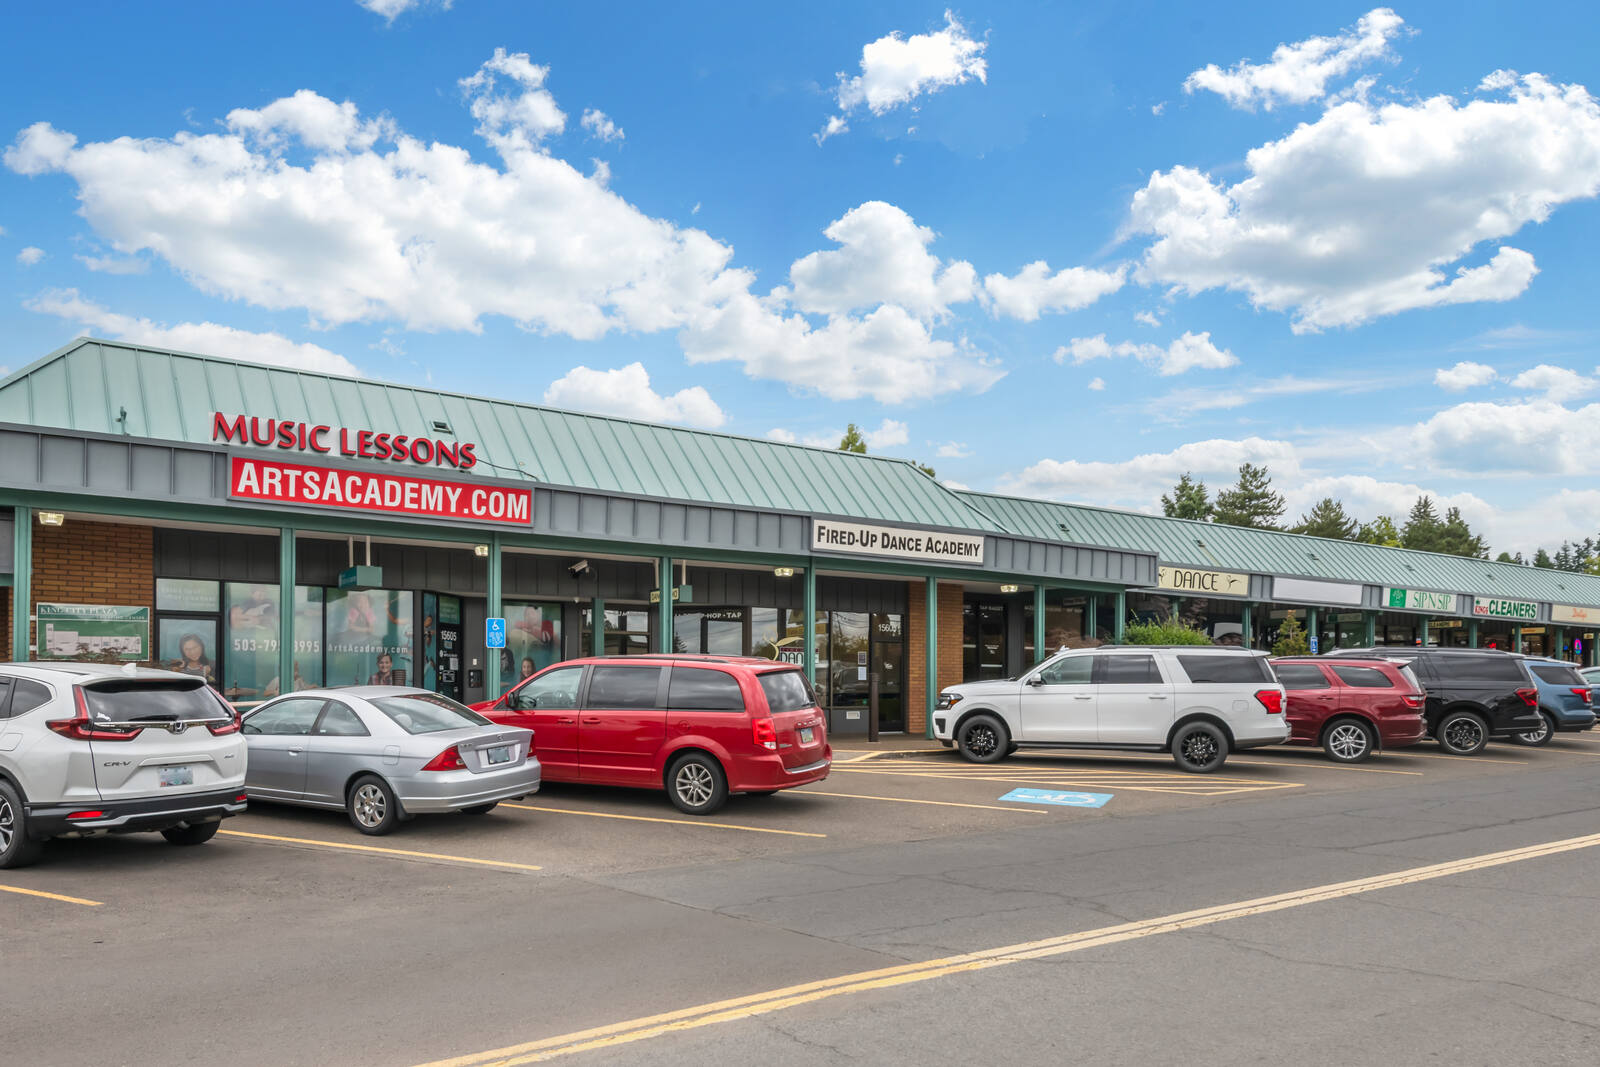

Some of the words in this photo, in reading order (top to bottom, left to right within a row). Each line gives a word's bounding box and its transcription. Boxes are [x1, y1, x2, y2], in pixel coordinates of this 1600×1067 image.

[212, 411, 331, 452] MUSIC
[340, 427, 477, 469] LESSONS
[236, 462, 528, 520] ARTSACADEMY.COM
[817, 525, 878, 548] FIRED-UP
[881, 532, 922, 552] DANCE
[925, 536, 981, 557] ACADEMY
[1173, 569, 1219, 591] DANCE
[1412, 591, 1427, 608] SIP
[1428, 592, 1437, 609] N
[1437, 593, 1452, 610] SIP
[1488, 599, 1537, 619] CLEANERS
[726, 611, 742, 619] TAP
[103, 760, 131, 768] CR-V
